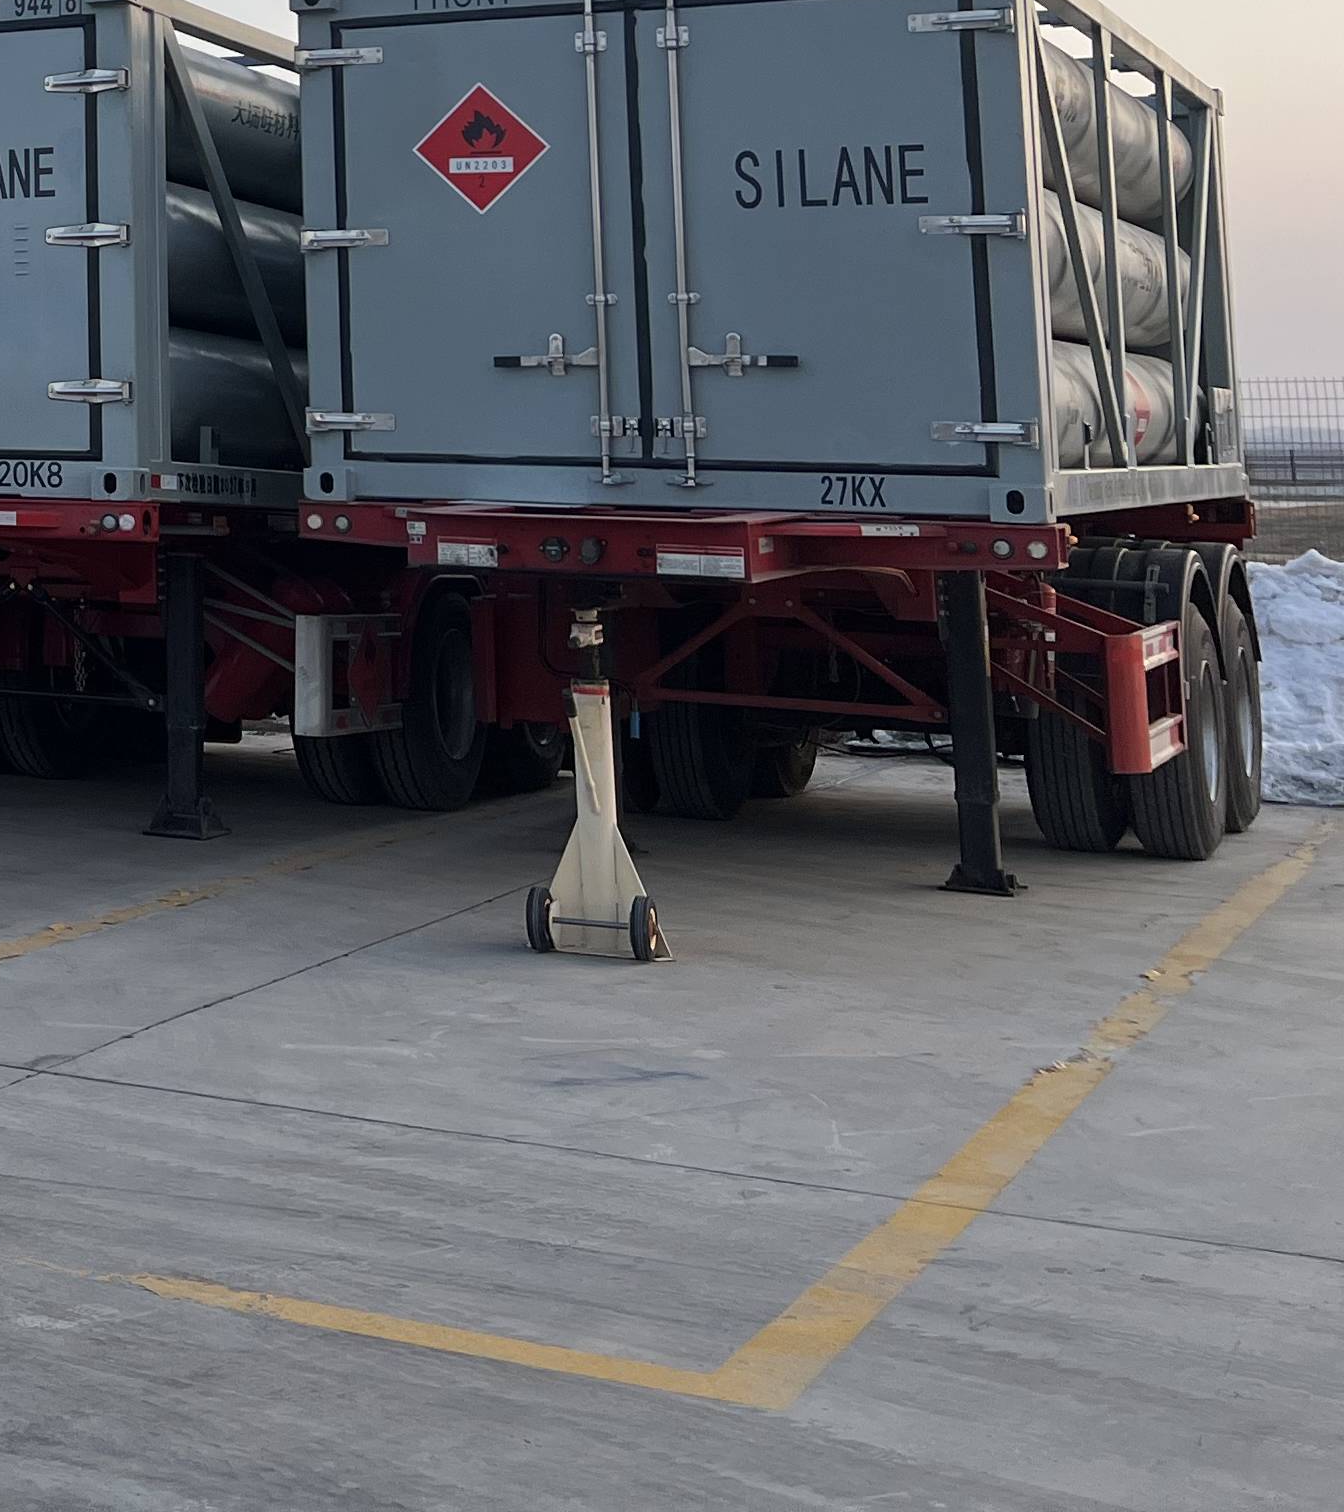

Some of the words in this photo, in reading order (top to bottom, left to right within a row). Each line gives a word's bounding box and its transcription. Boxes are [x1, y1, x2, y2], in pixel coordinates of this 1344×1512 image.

[455, 159, 507, 171] UN2203
[734, 143, 930, 210] SILANE
[820, 474, 888, 508] 27KX
